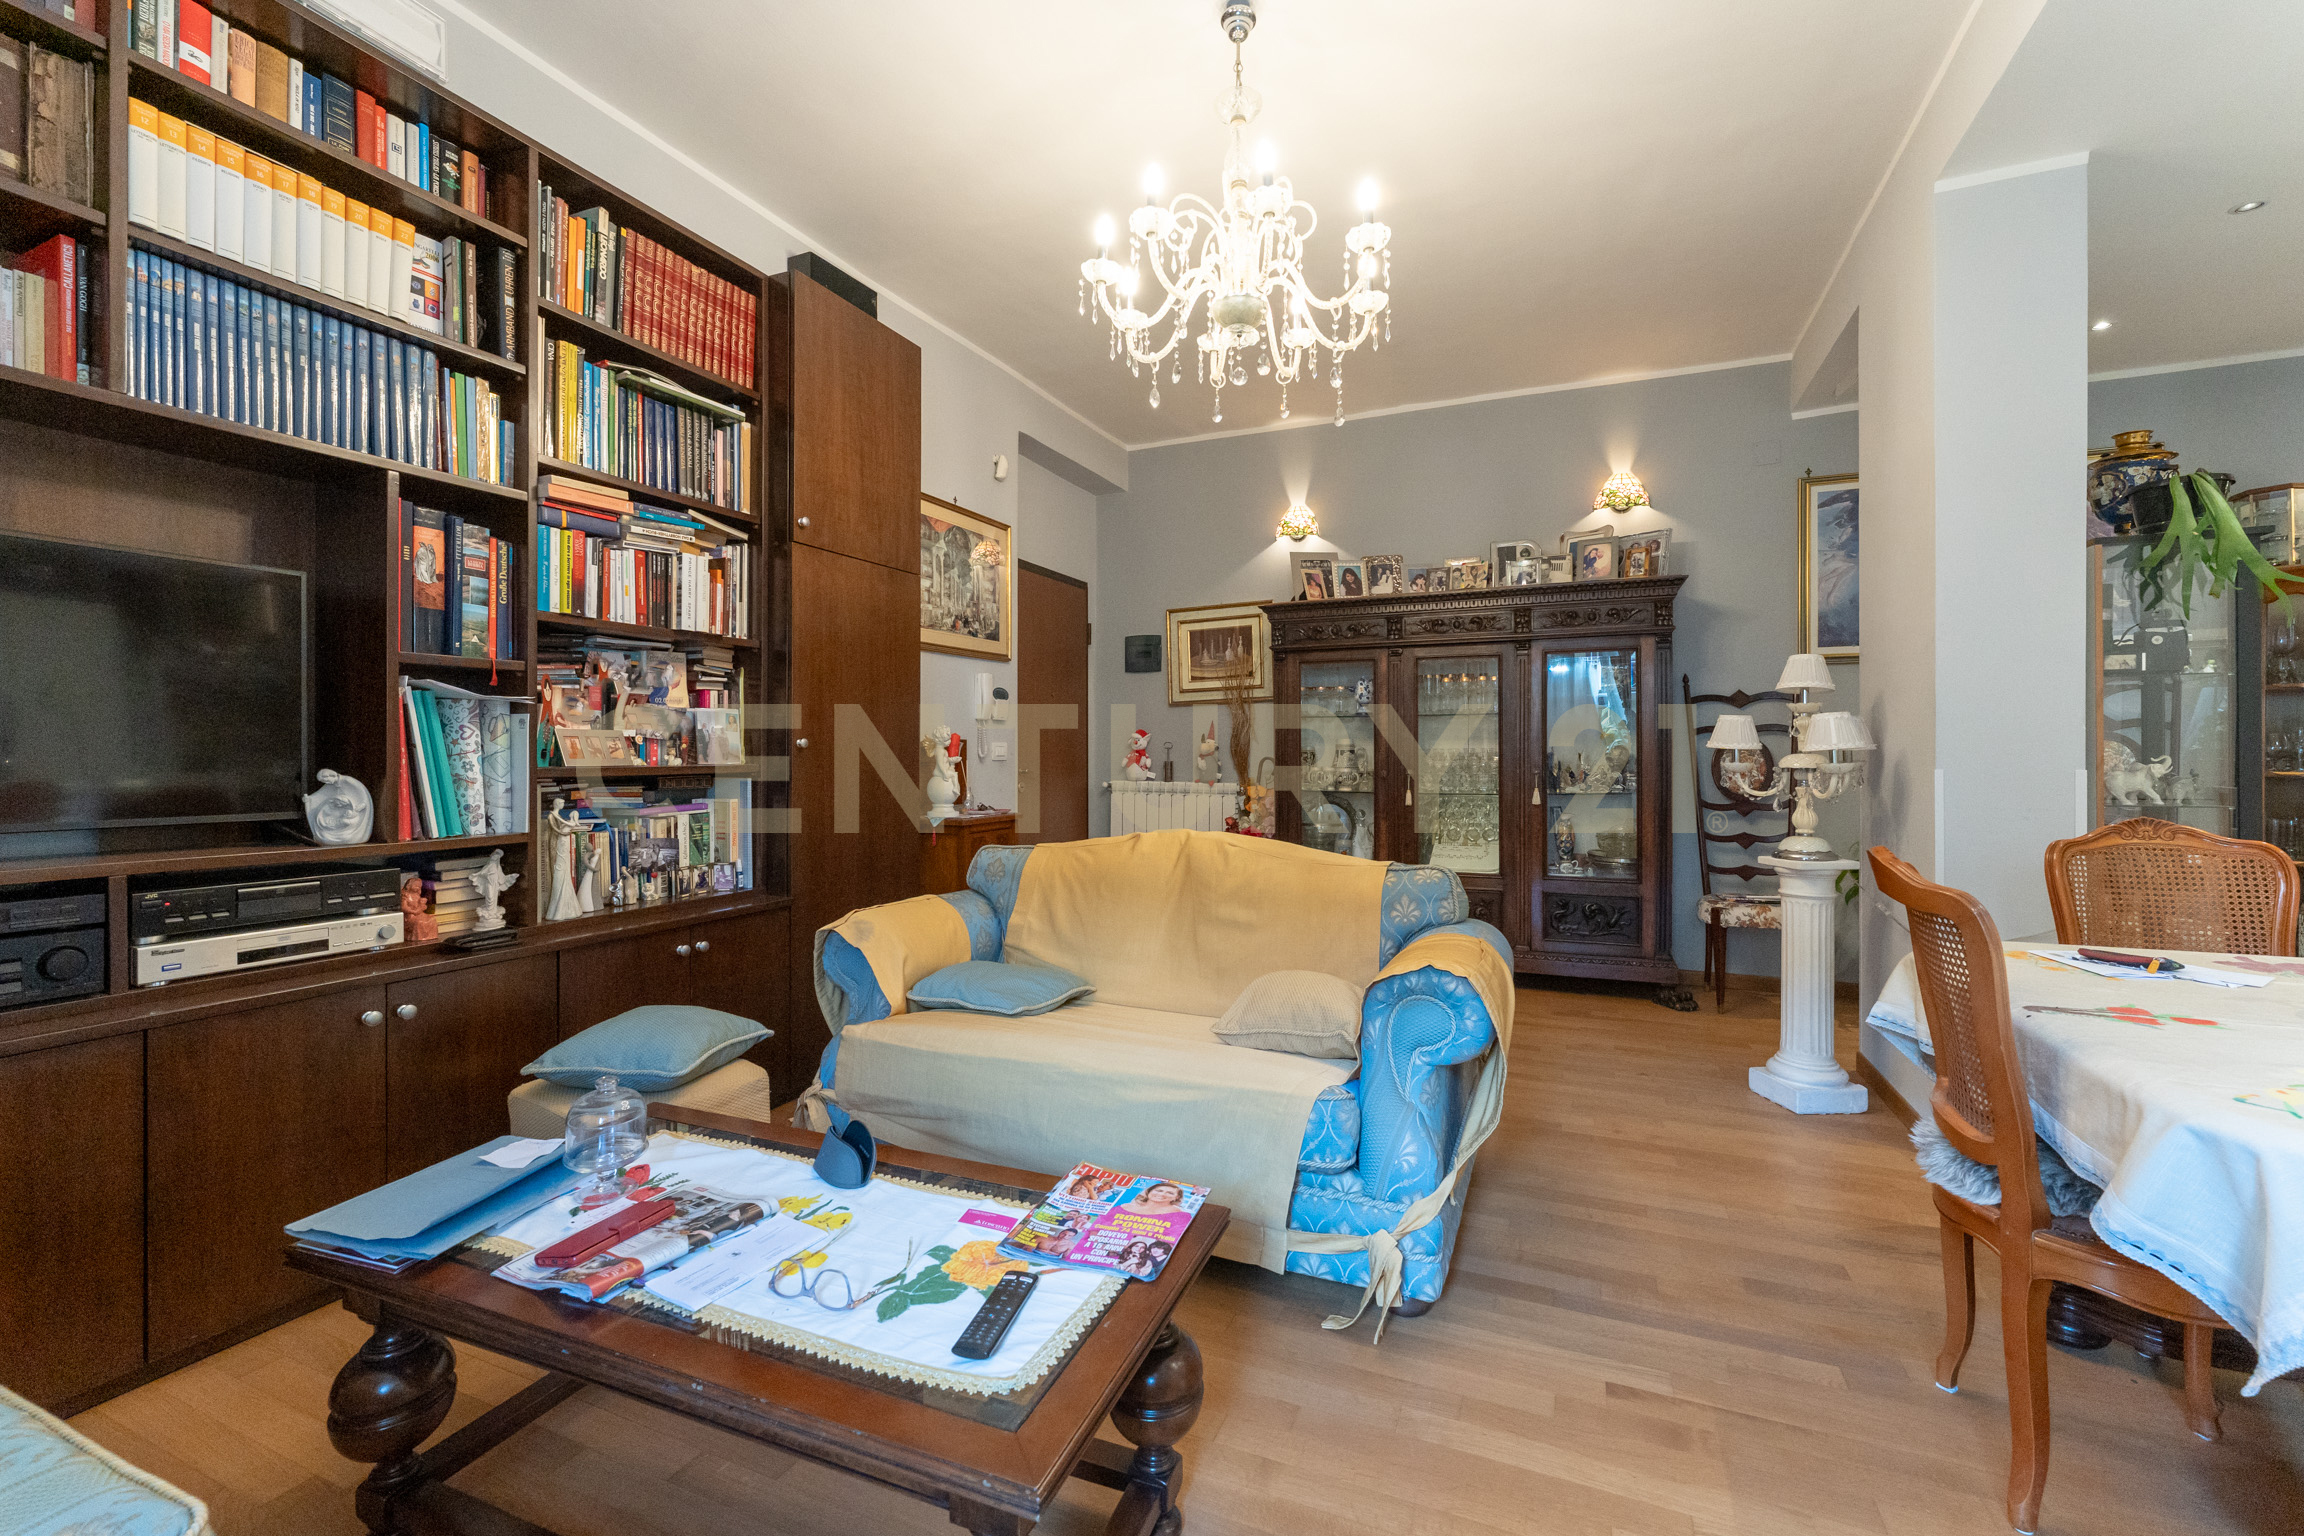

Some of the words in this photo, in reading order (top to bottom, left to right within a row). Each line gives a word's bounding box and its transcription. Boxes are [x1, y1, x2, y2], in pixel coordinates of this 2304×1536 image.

[140, 116, 149, 125] 12
[169, 130, 177, 139] 13
[198, 144, 206, 152] 14
[227, 156, 235, 165] 15
[257, 170, 264, 178] 16
[308, 190, 316, 198] 18
[330, 202, 338, 210] 19
[355, 213, 363, 221] 20
[378, 223, 385, 231] 21
[401, 232, 408, 240] 22
[599, 235, 608, 280] LEONARDO
[63, 244, 73, 289] CALLANETICS
[79, 276, 87, 291] VAN
[504, 265, 514, 295] UHREN
[80, 291, 88, 312] GOGH
[505, 308, 514, 351] ARMBAND
[499, 544, 507, 580] Deutsche
[499, 580, 507, 605] Große
[1113, 1213, 1172, 1229] ROMINA
[1113, 1220, 1166, 1234] POWER
[1097, 1229, 1128, 1240] DOVEVO
[1131, 1229, 1147, 1237] anni
[1154, 1233, 1176, 1242] rivela
[1088, 1235, 1130, 1247] SPOSARMI
[1090, 1248, 1109, 1257] CON
[1103, 1244, 1125, 1252] ANNI
[1070, 1252, 1083, 1260] UN
[1082, 1254, 1120, 1266] PRINCIPE
